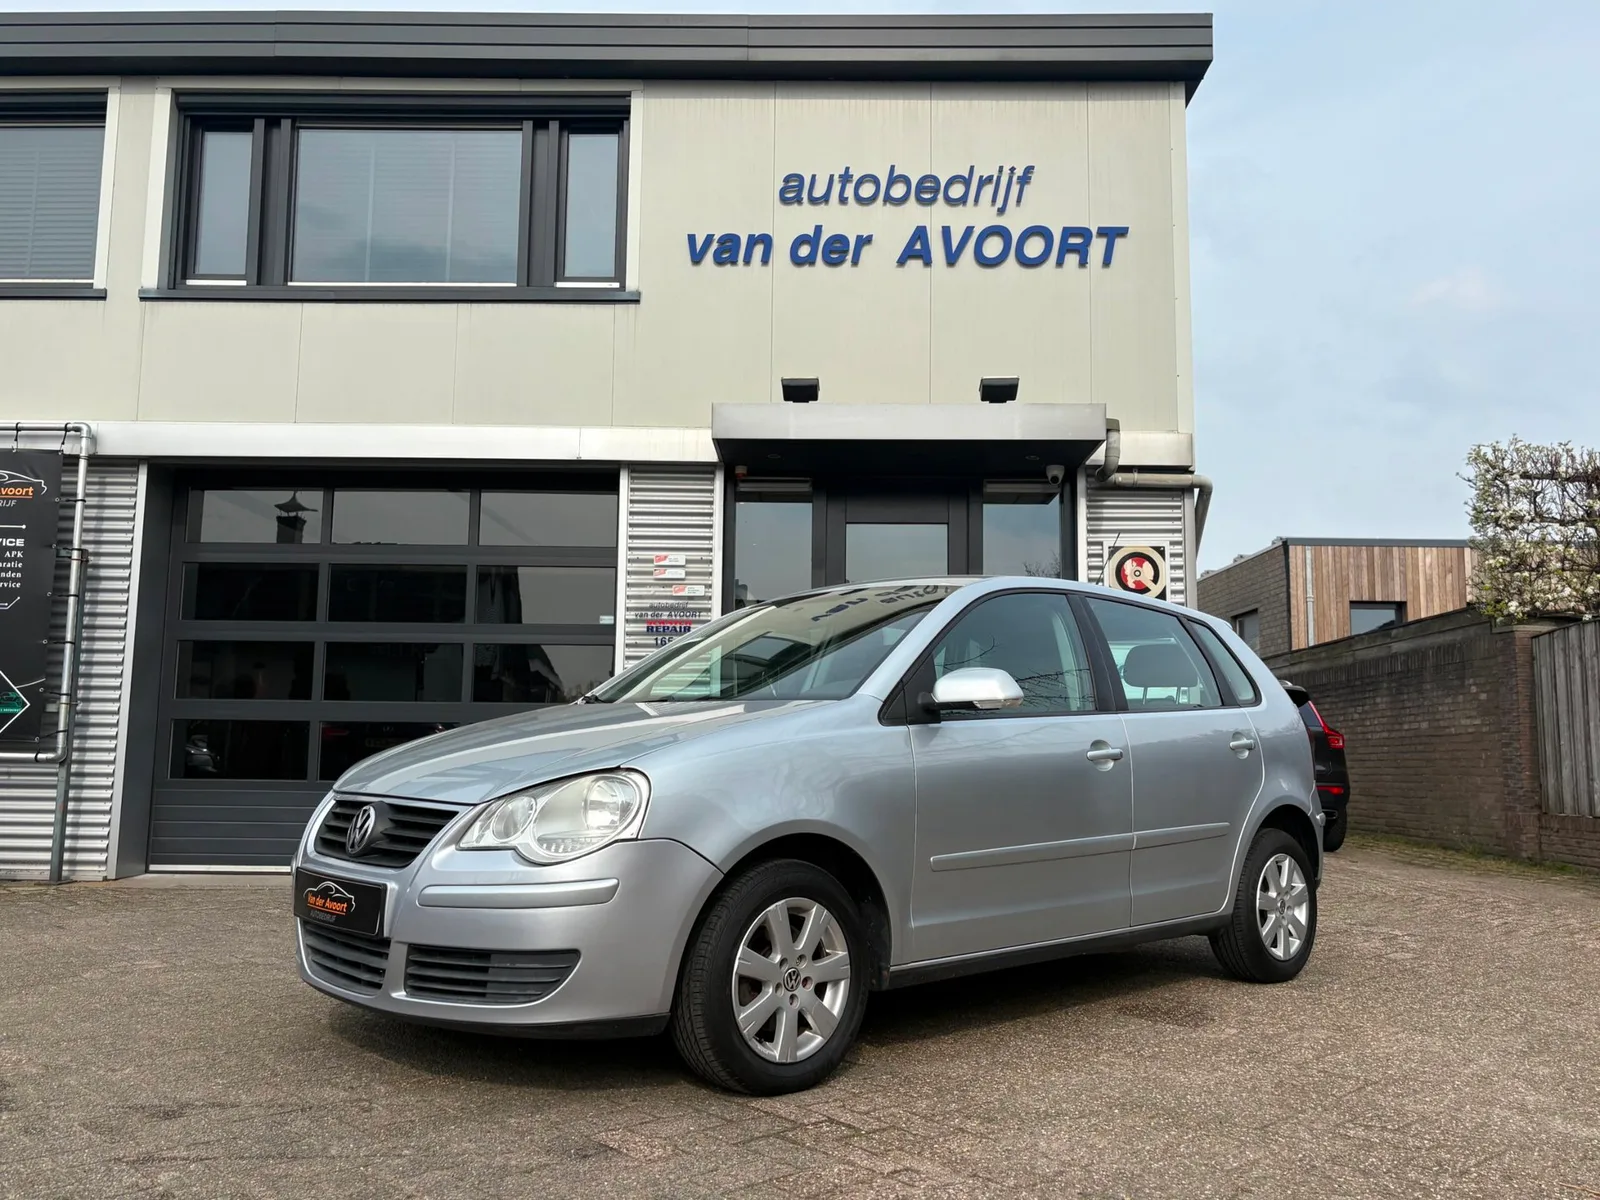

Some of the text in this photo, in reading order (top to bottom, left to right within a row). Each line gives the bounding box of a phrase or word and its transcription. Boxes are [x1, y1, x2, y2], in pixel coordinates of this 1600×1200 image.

[779, 165, 1035, 214] autobedrijf
[687, 225, 1129, 268] van der AVOORT
[0, 486, 34, 496] voort
